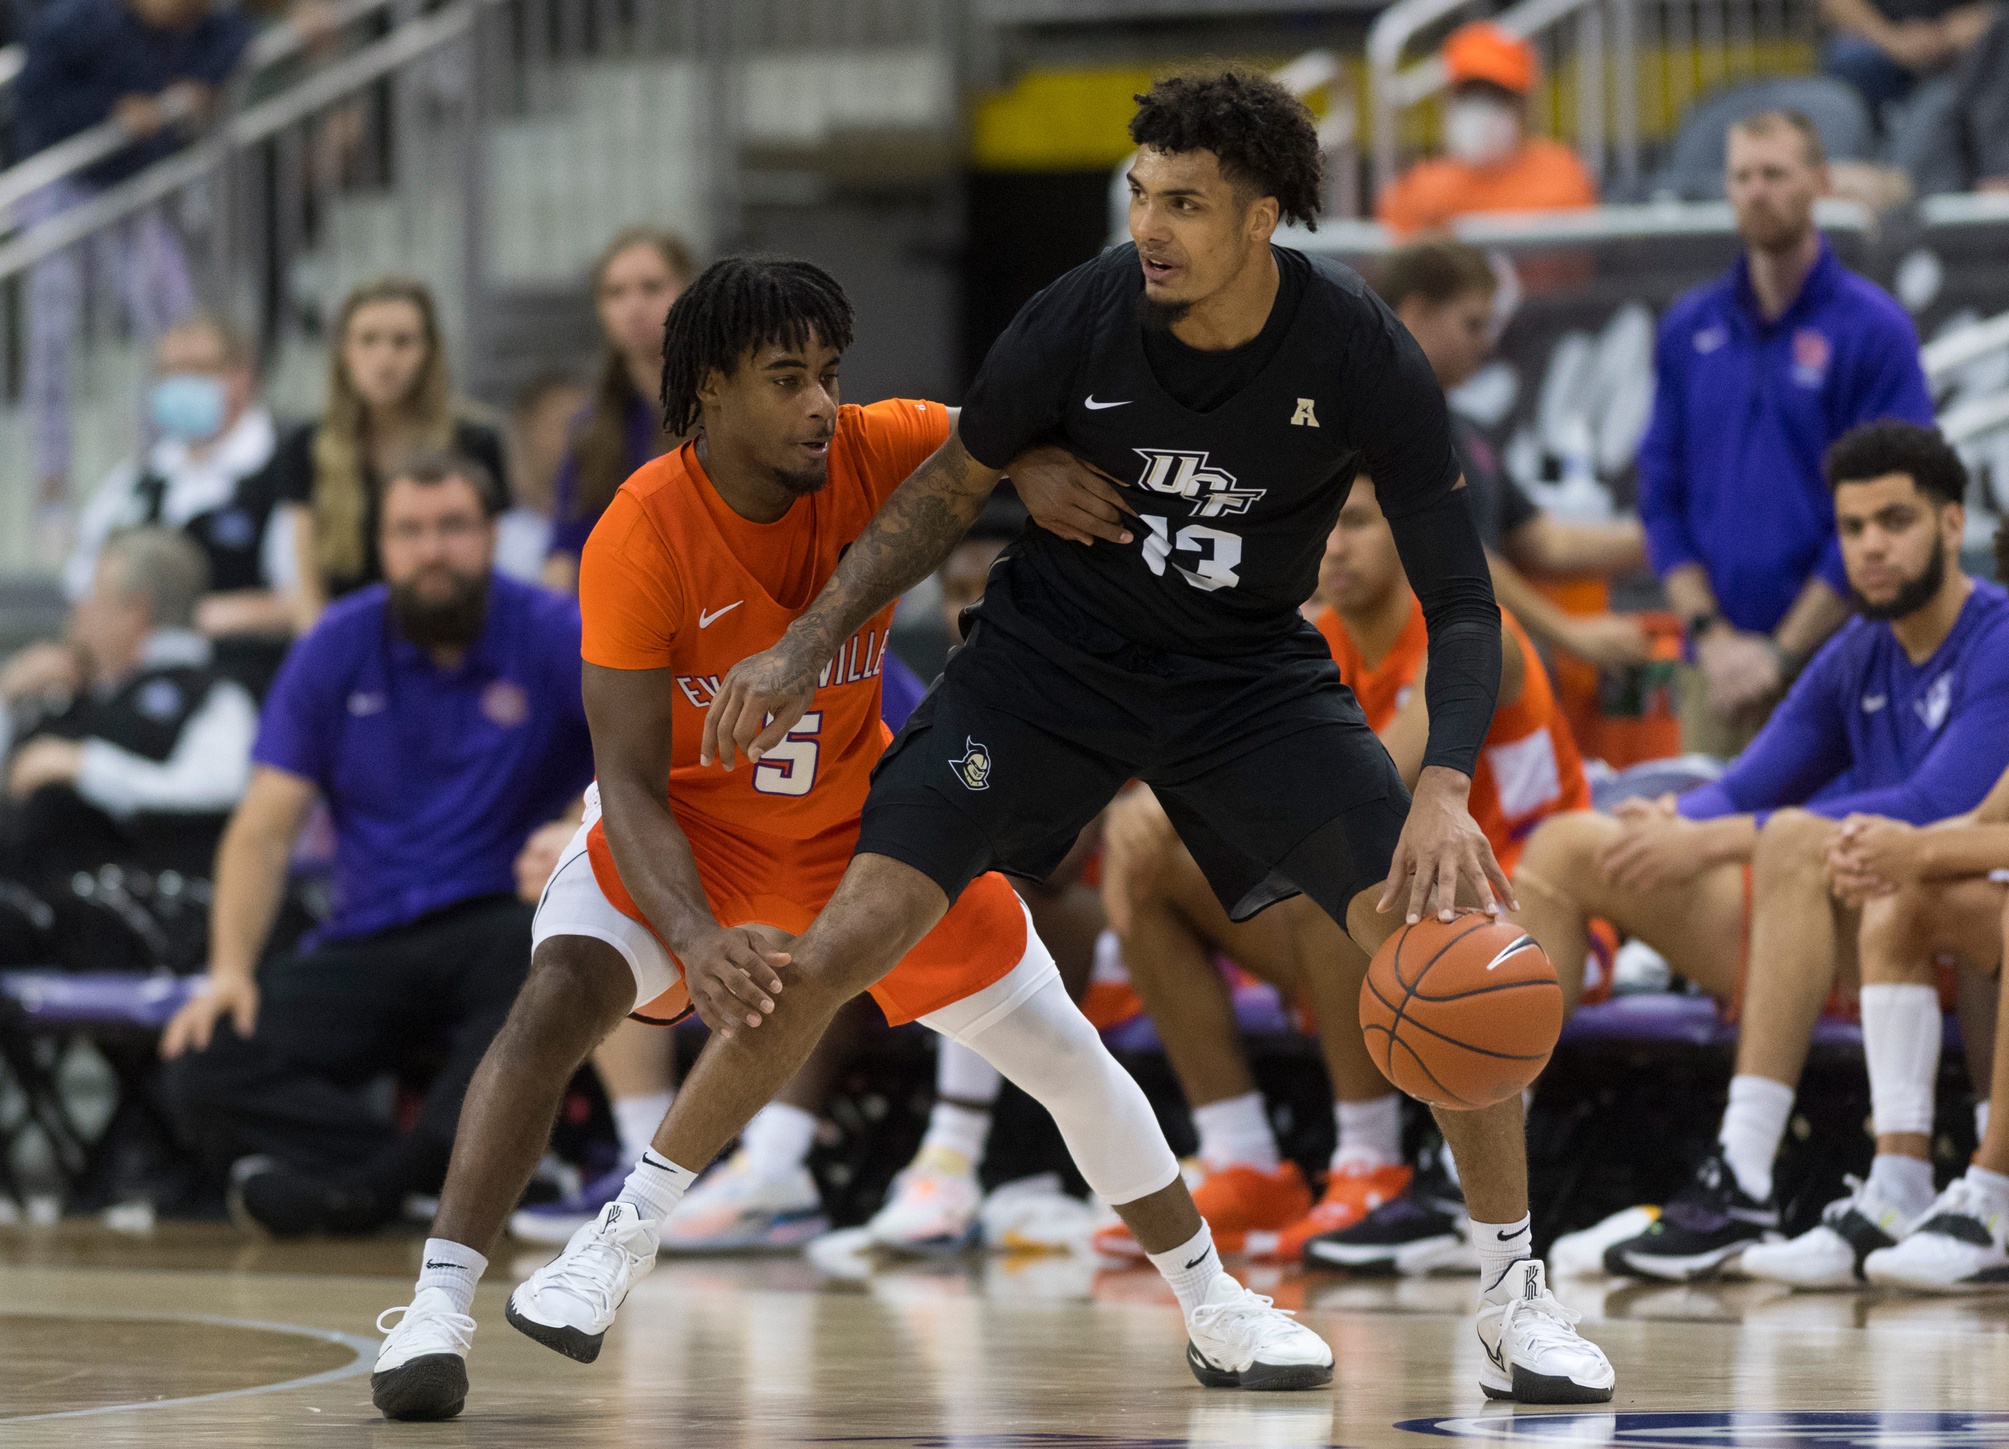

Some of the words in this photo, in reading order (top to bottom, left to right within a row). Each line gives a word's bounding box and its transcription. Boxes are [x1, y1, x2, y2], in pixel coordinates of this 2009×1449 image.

[1132, 448, 1267, 517] UCF
[1138, 513, 1243, 592] 13
[675, 627, 890, 708] EVVILLE
[752, 710, 824, 797] 5
